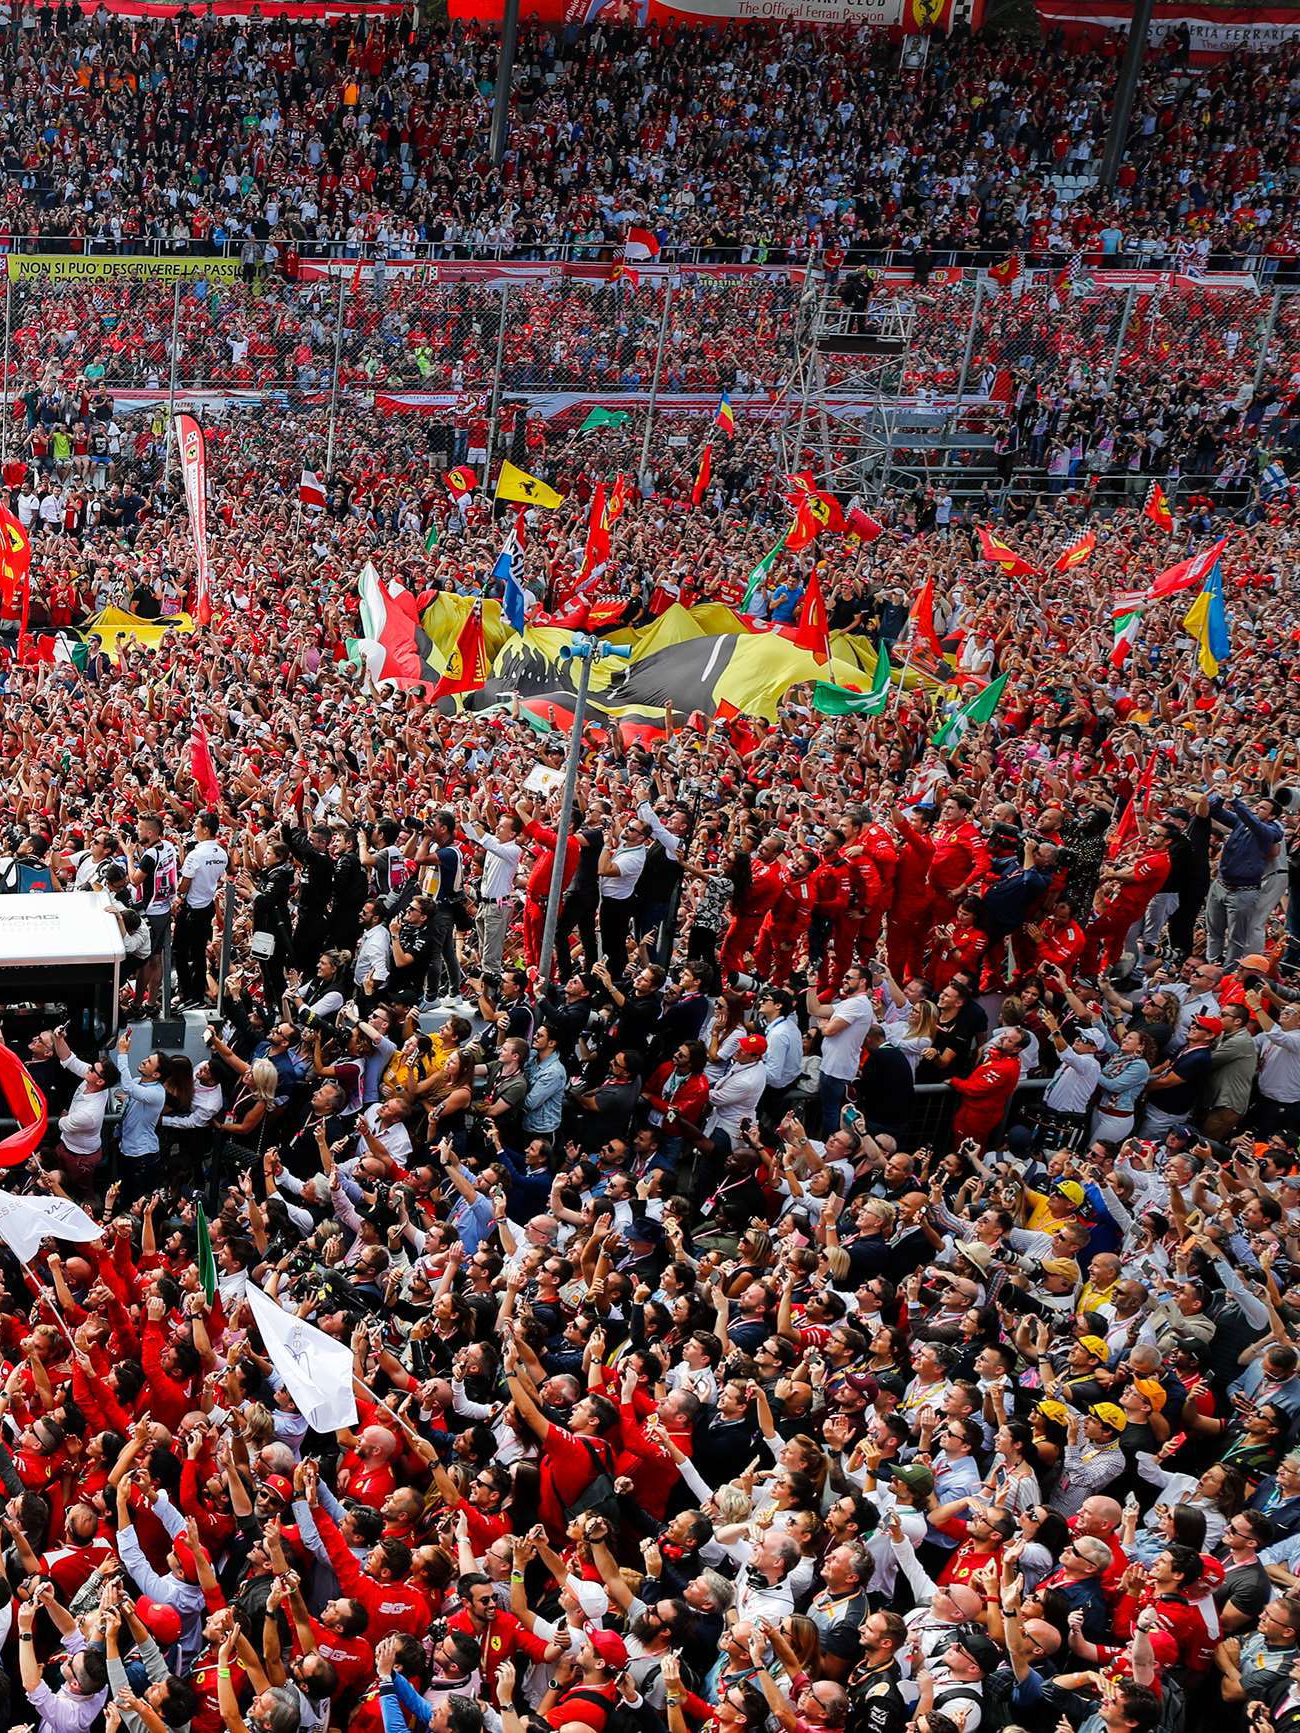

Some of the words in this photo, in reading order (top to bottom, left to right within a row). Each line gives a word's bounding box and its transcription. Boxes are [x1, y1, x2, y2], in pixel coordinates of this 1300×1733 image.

[739, 2, 759, 14] The
[762, 2, 802, 16] Official
[806, 7, 839, 19] Ferrari
[843, 8, 884, 21] Passion
[1147, 25, 1218, 39] SCUERIA
[1226, 29, 1284, 40] FERRARI
[55, 262, 64, 274] SI
[103, 263, 181, 276] DESCRIVERE
